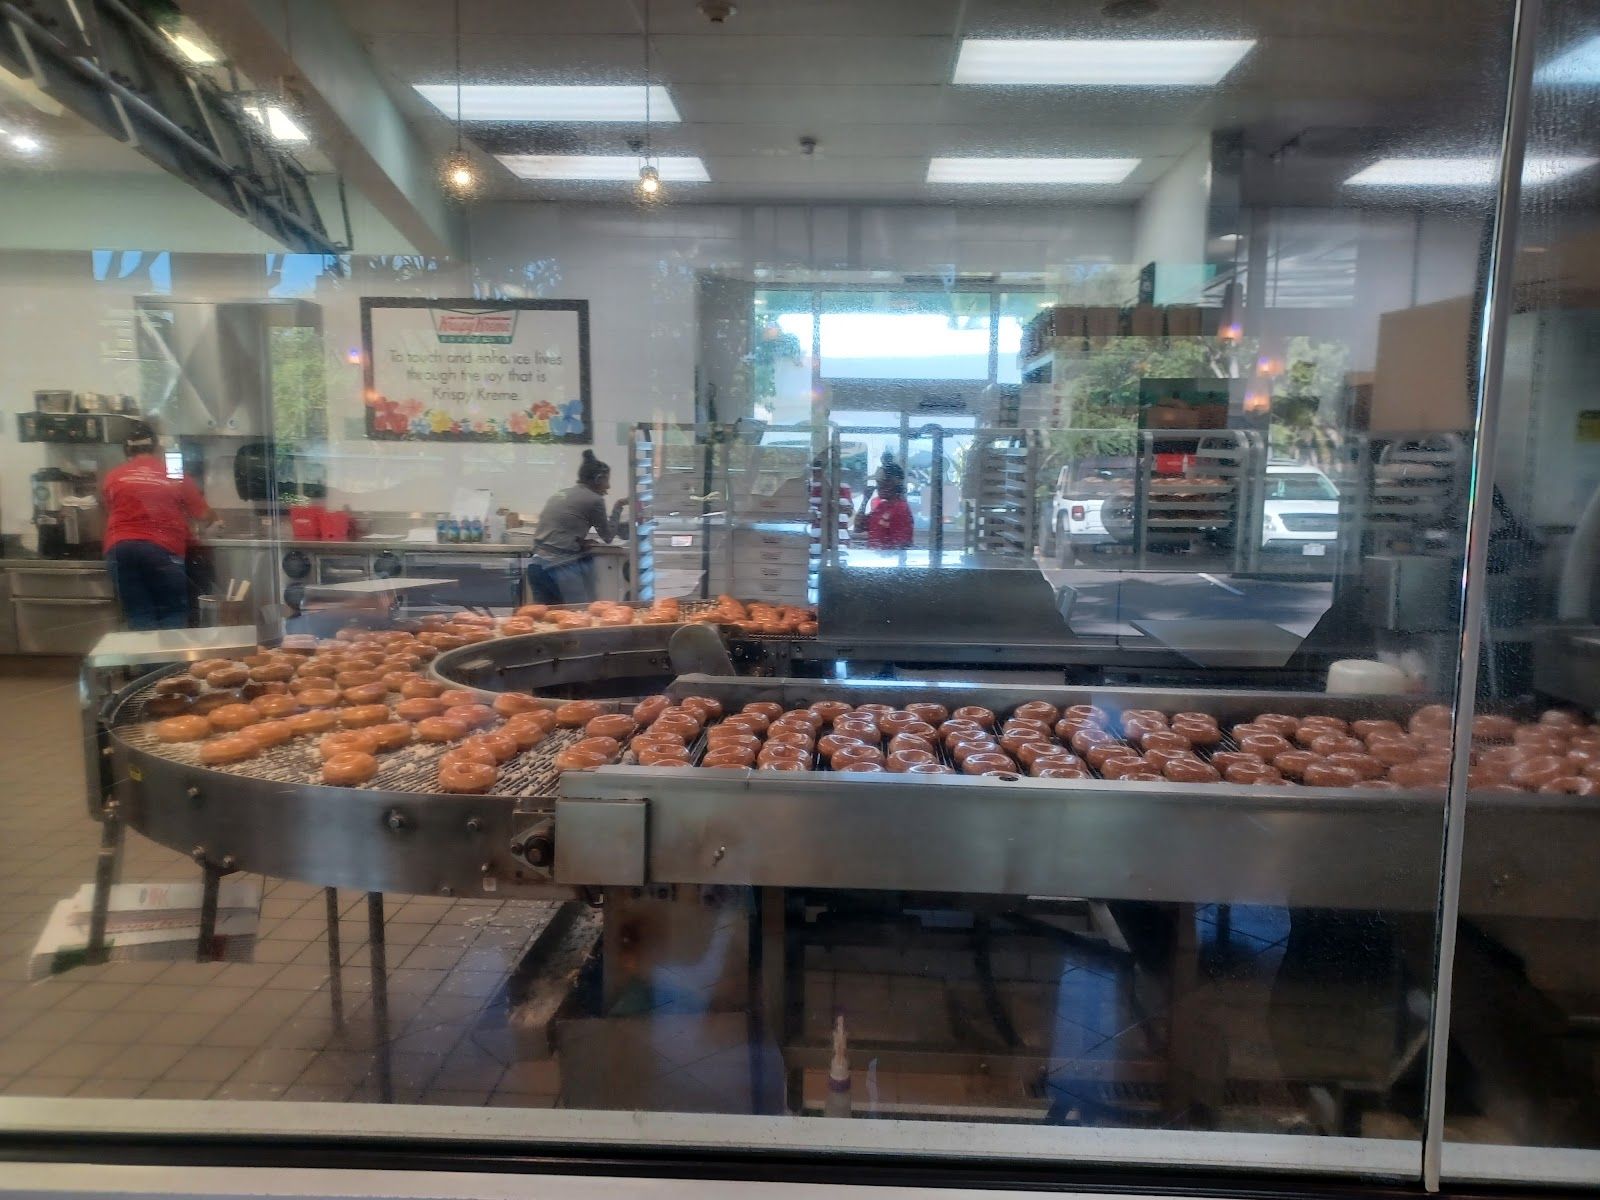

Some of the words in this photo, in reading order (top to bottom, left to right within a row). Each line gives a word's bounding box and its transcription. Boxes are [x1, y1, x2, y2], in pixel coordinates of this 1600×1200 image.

[388, 349, 403, 363] To
[406, 349, 442, 364] touch
[447, 349, 472, 364] and
[534, 350, 562, 366] lives
[406, 368, 456, 385] through
[460, 369, 480, 381] the
[508, 368, 533, 382] that
[536, 369, 546, 382] is
[433, 387, 472, 404] Krispy
